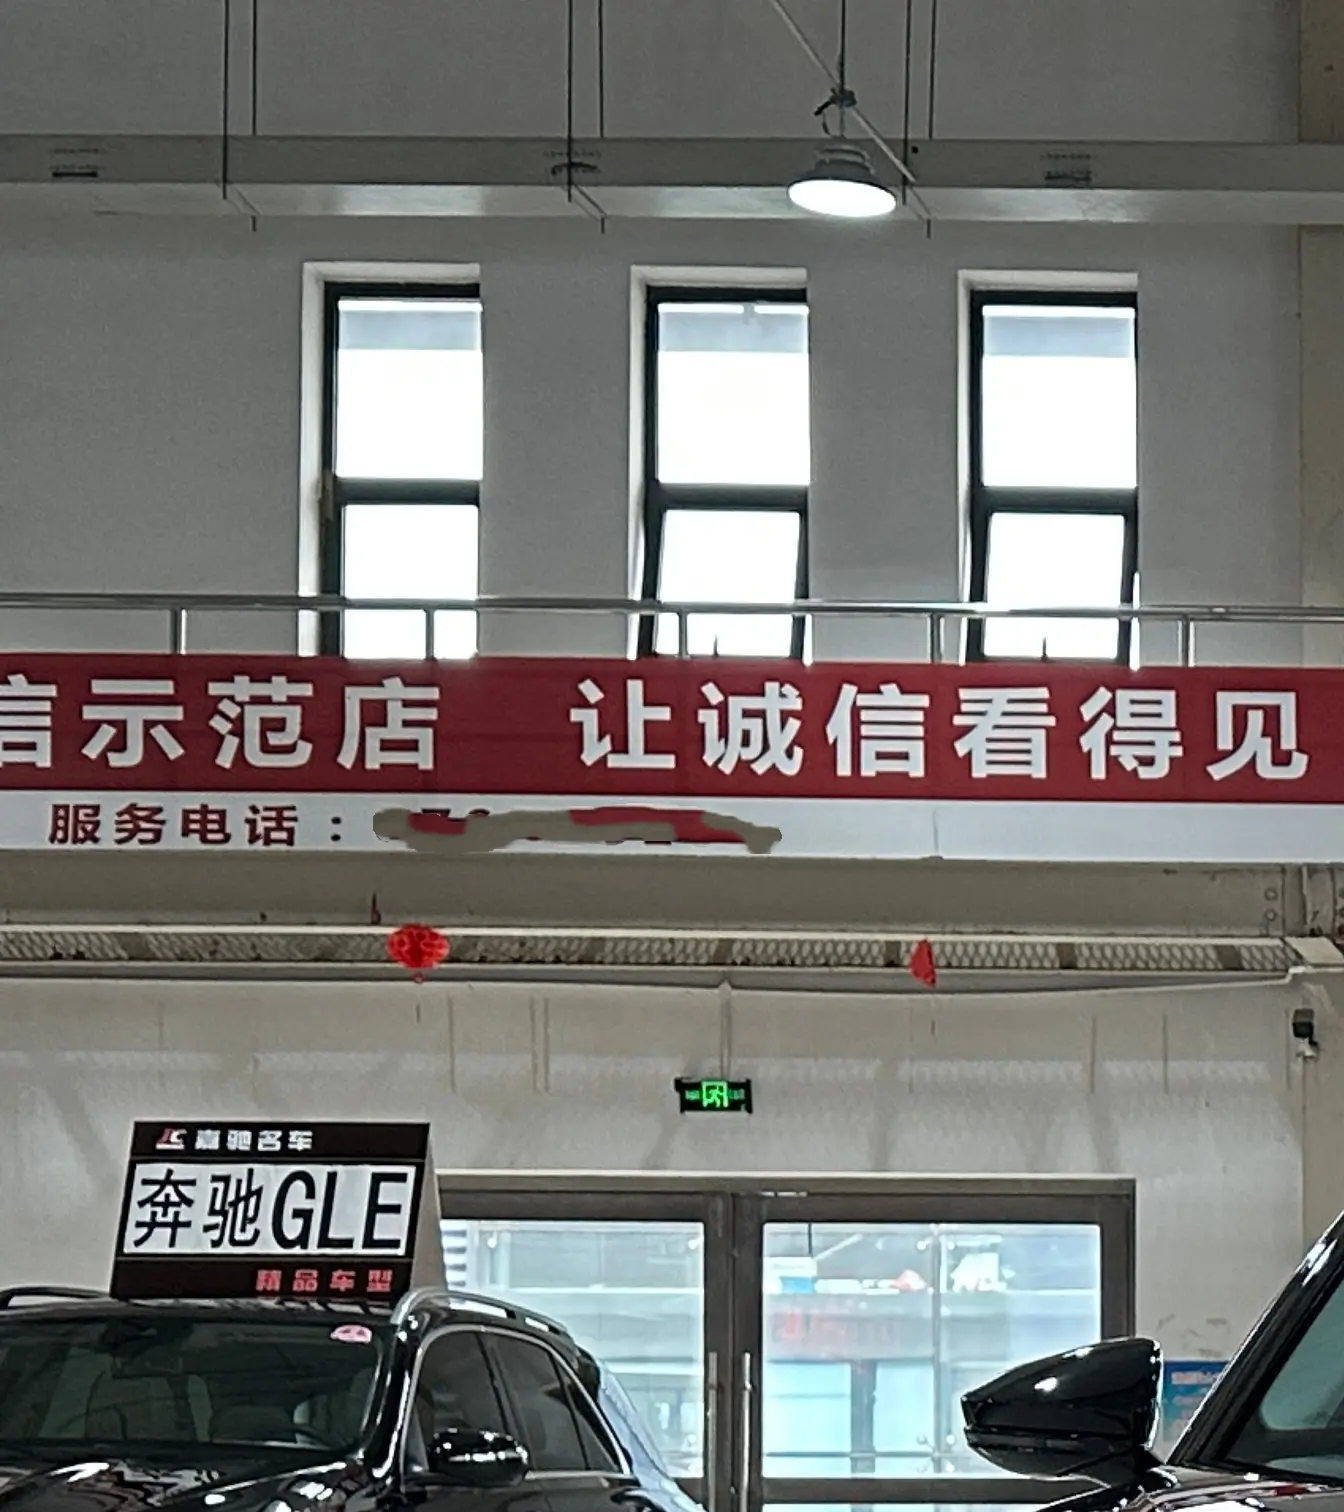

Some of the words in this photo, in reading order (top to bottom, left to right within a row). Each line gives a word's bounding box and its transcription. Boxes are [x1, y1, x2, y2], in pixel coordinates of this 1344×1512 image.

[570, 678, 1309, 781] 让诚信看得见
[48, 802, 345, 847] 服务电话：
[133, 1168, 409, 1250] 奔驰GLE
[255, 1269, 393, 1293] 精品车型
